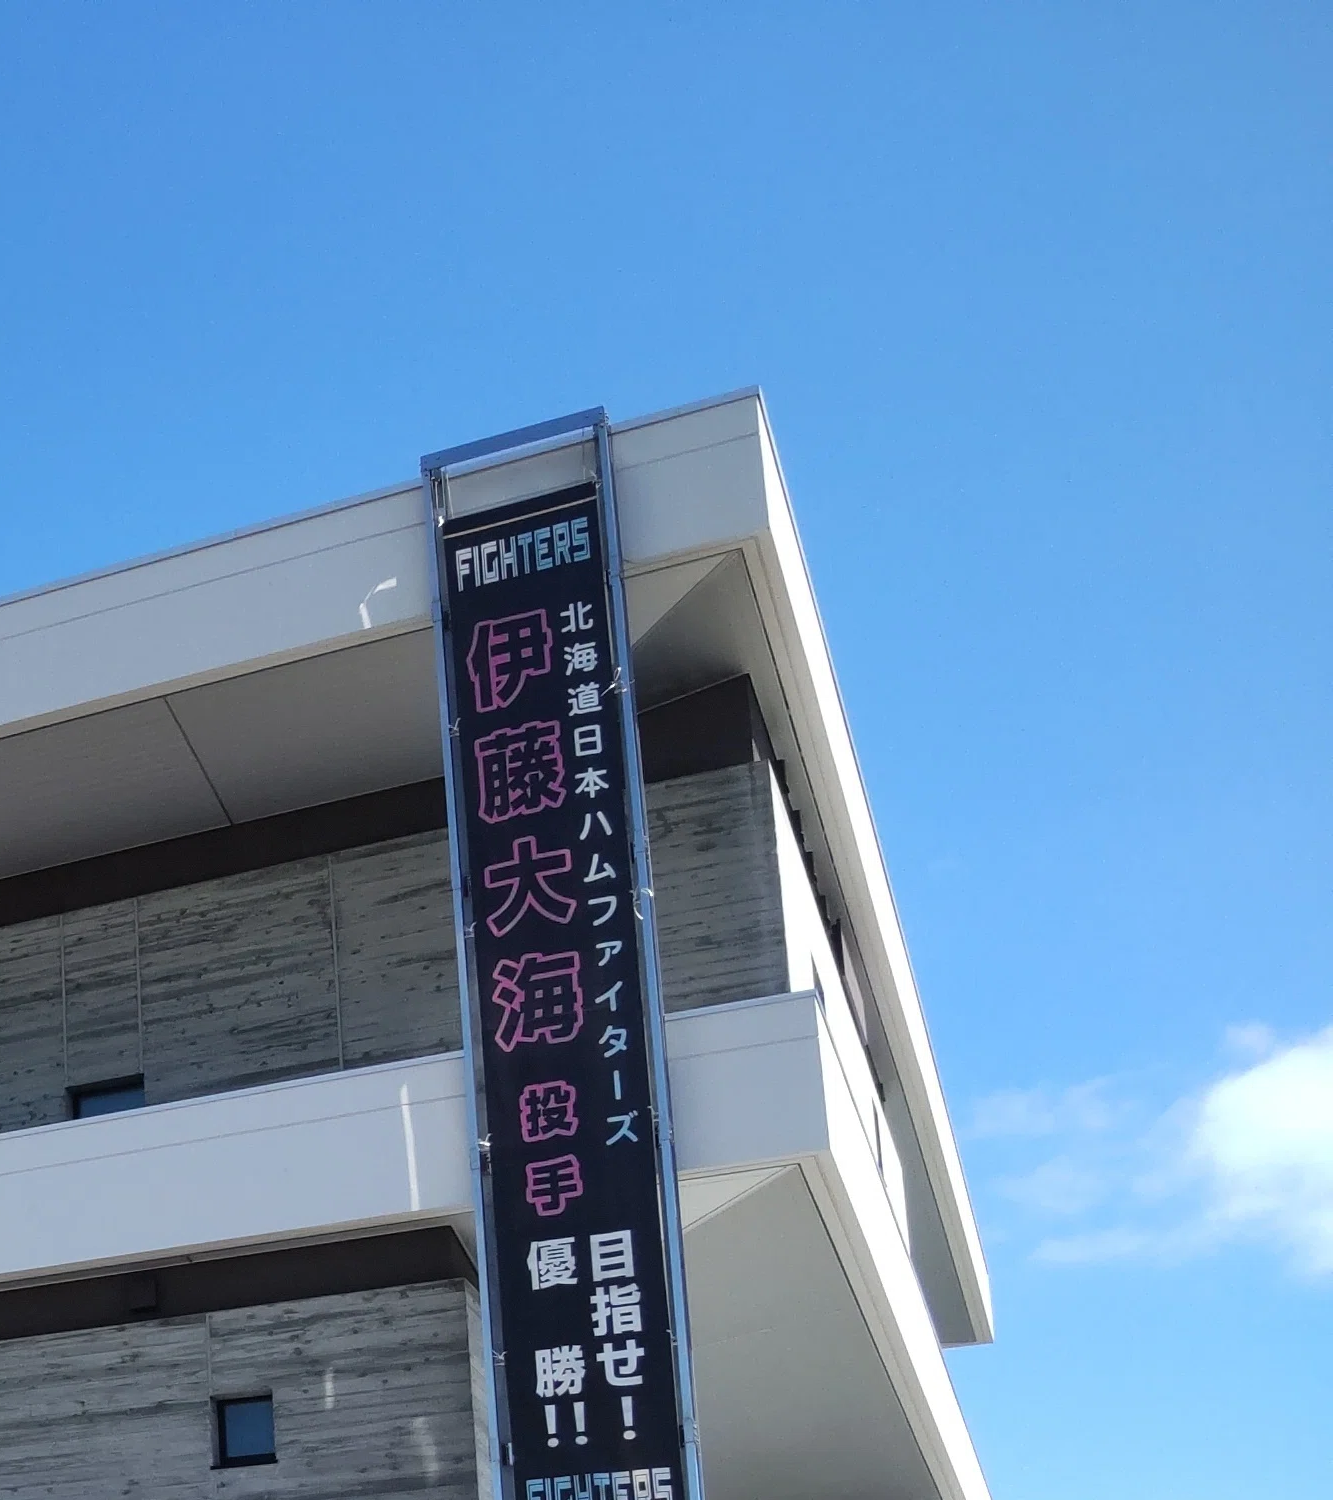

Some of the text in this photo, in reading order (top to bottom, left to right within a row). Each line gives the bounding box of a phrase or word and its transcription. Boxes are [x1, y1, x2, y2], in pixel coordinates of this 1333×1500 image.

[455, 516, 592, 593] FIGHTERS
[559, 600, 638, 1147] 北海道日本ハムファイターズ
[589, 1228, 645, 1441] 目指せ!
